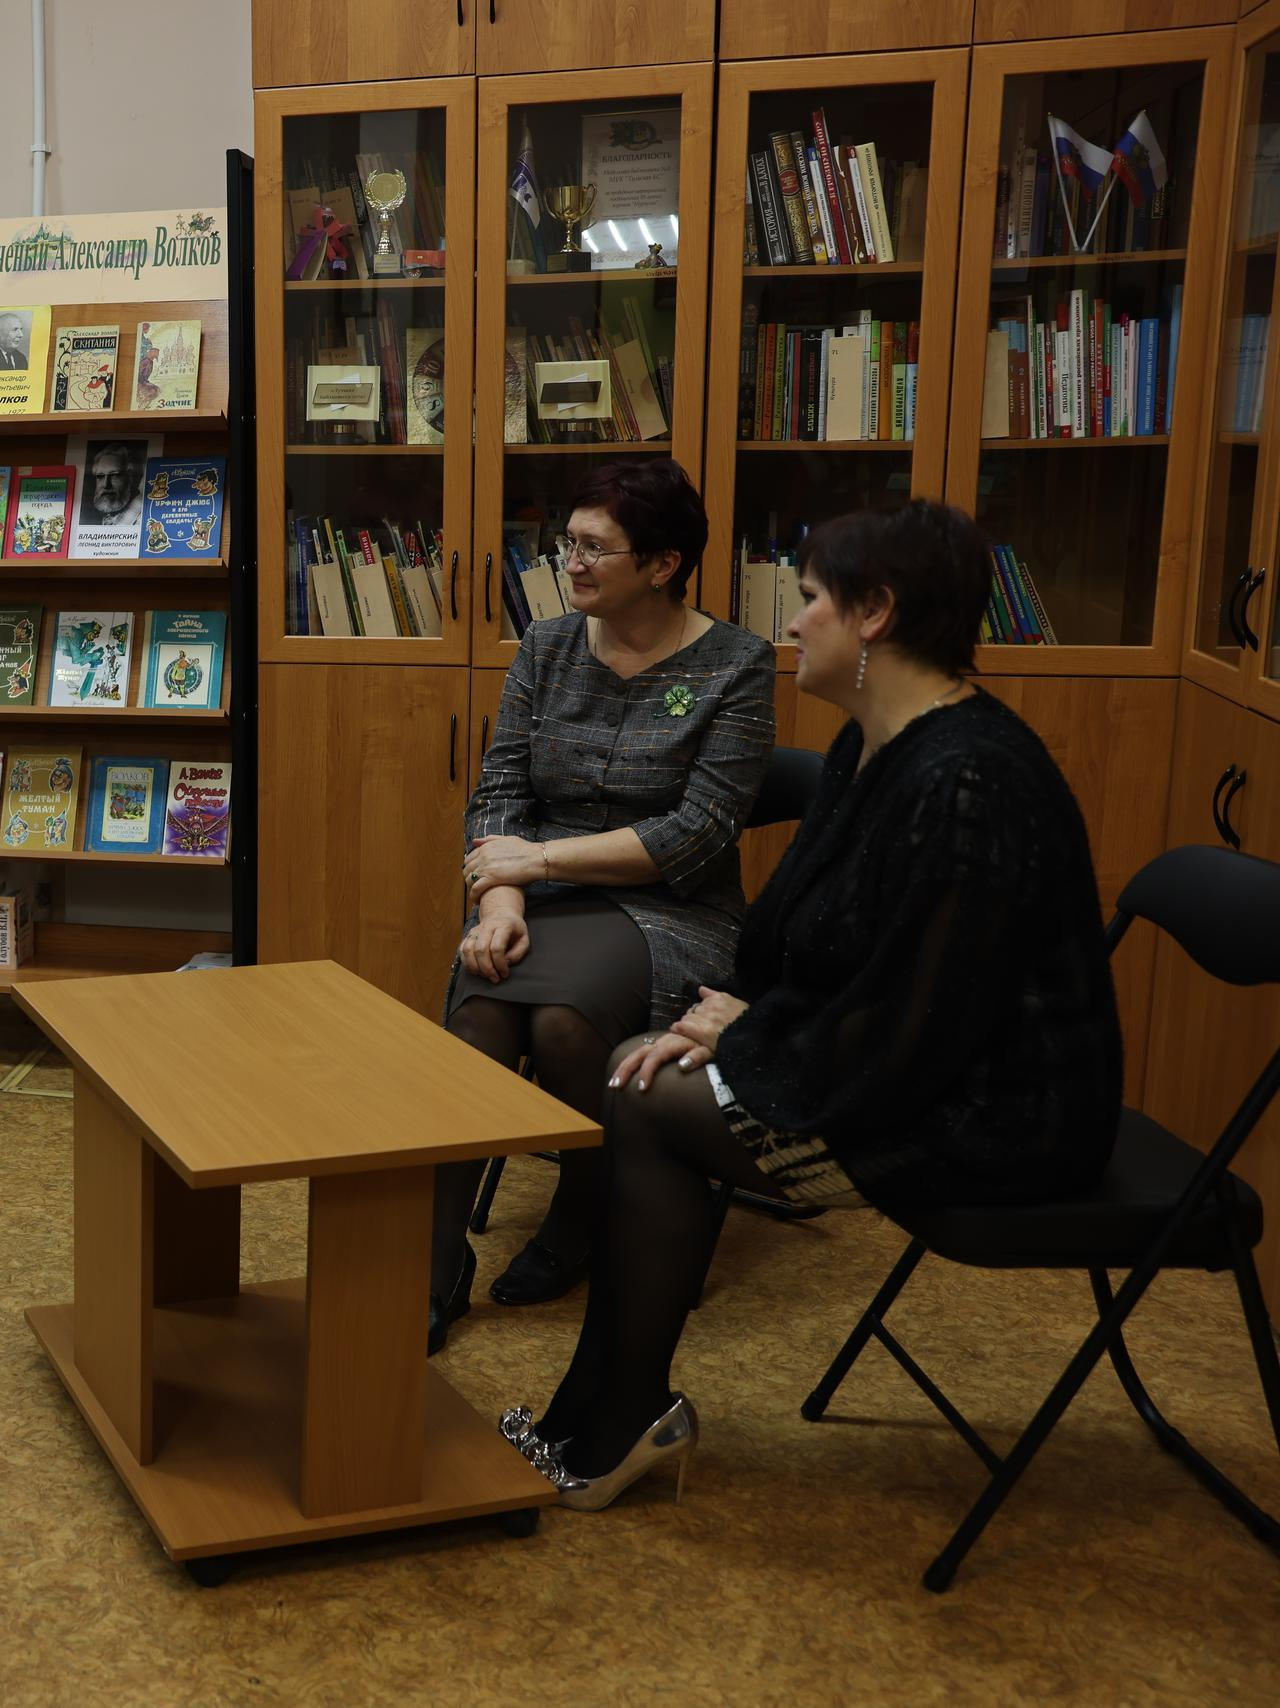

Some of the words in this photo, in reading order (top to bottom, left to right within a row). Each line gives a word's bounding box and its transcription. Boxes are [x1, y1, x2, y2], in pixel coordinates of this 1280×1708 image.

[814, 121, 824, 145] ПОРУ
[602, 152, 672, 163] БЛАГОДАРНОСТЬ
[756, 157, 768, 180] ДАТАХ
[820, 146, 835, 191] ГРОЗНУЮ
[869, 177, 879, 204] ИСТОРИЯ
[1021, 180, 1033, 237] ГЕОПОЛИТИКА
[764, 208, 779, 242] ИСТОРИЯ
[52, 232, 148, 280] Александр
[152, 227, 220, 267] Волков
[74, 339, 115, 349] СКИТАНИЯ
[895, 377, 904, 428] КУЛЬТУРОЛОГИЯ
[1061, 373, 1069, 414] Педагогика
[155, 499, 182, 507] УРФИН
[185, 499, 211, 507] ДЖЮС
[78, 533, 138, 541] ВЛАДИМИРСКИЙ
[179, 767, 189, 780] А.
[18, 794, 61, 802] ЖЕЛТЫЙ
[22, 805, 55, 813] ТУМАН
